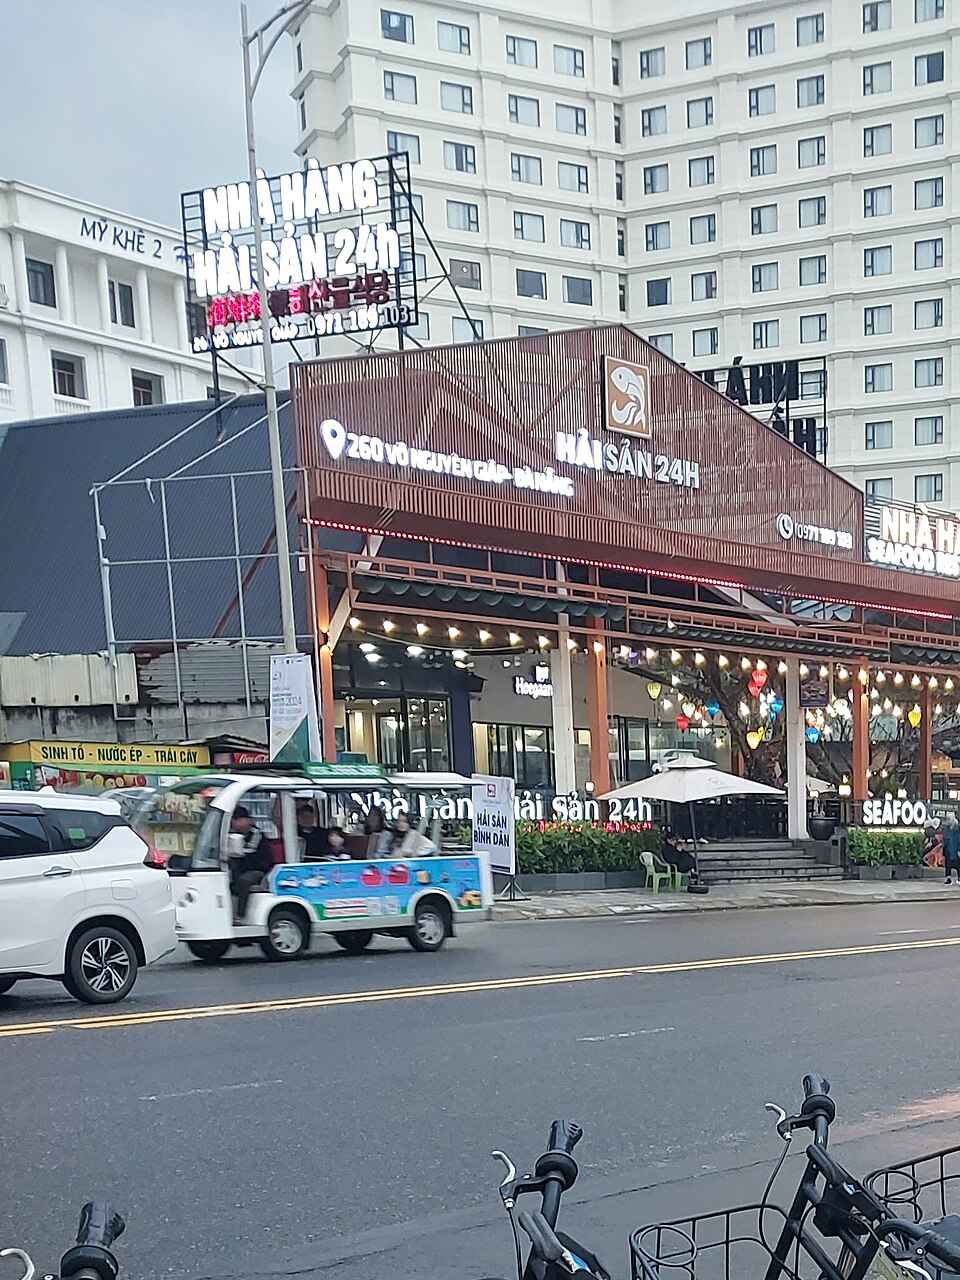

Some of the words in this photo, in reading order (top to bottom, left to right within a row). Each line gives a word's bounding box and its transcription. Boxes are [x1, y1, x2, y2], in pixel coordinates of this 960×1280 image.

[280, 157, 379, 221] HÀNG
[80, 217, 108, 242] MỸ
[113, 227, 145, 254] KHÊ
[153, 239, 162, 259] 2
[193, 232, 252, 297] HẢI
[260, 222, 328, 288] SẢN
[333, 223, 400, 276] 24h
[346, 431, 384, 462] 260
[555, 427, 603, 470] HẢI
[602, 437, 654, 480] SẢN
[654, 454, 701, 491] 24H
[881, 502, 934, 548] NHÀ
[867, 537, 936, 572] SEAFOOD
[41, 746, 69, 760] SINH
[70, 744, 85, 761] TỐ
[97, 746, 127, 762] NƯỚC
[129, 746, 143, 762] ÉP
[154, 748, 178, 764] TRÁI
[179, 749, 199, 764] CÂY
[419, 787, 472, 821] Hàn
[552, 790, 600, 821] Sản
[607, 797, 653, 823] 24h
[476, 809, 490, 827] HẢI
[491, 811, 507, 829] SẢN
[863, 798, 926, 825] SEAFOO
[474, 827, 491, 845] BÌNH
[493, 830, 510, 847] DÂN
